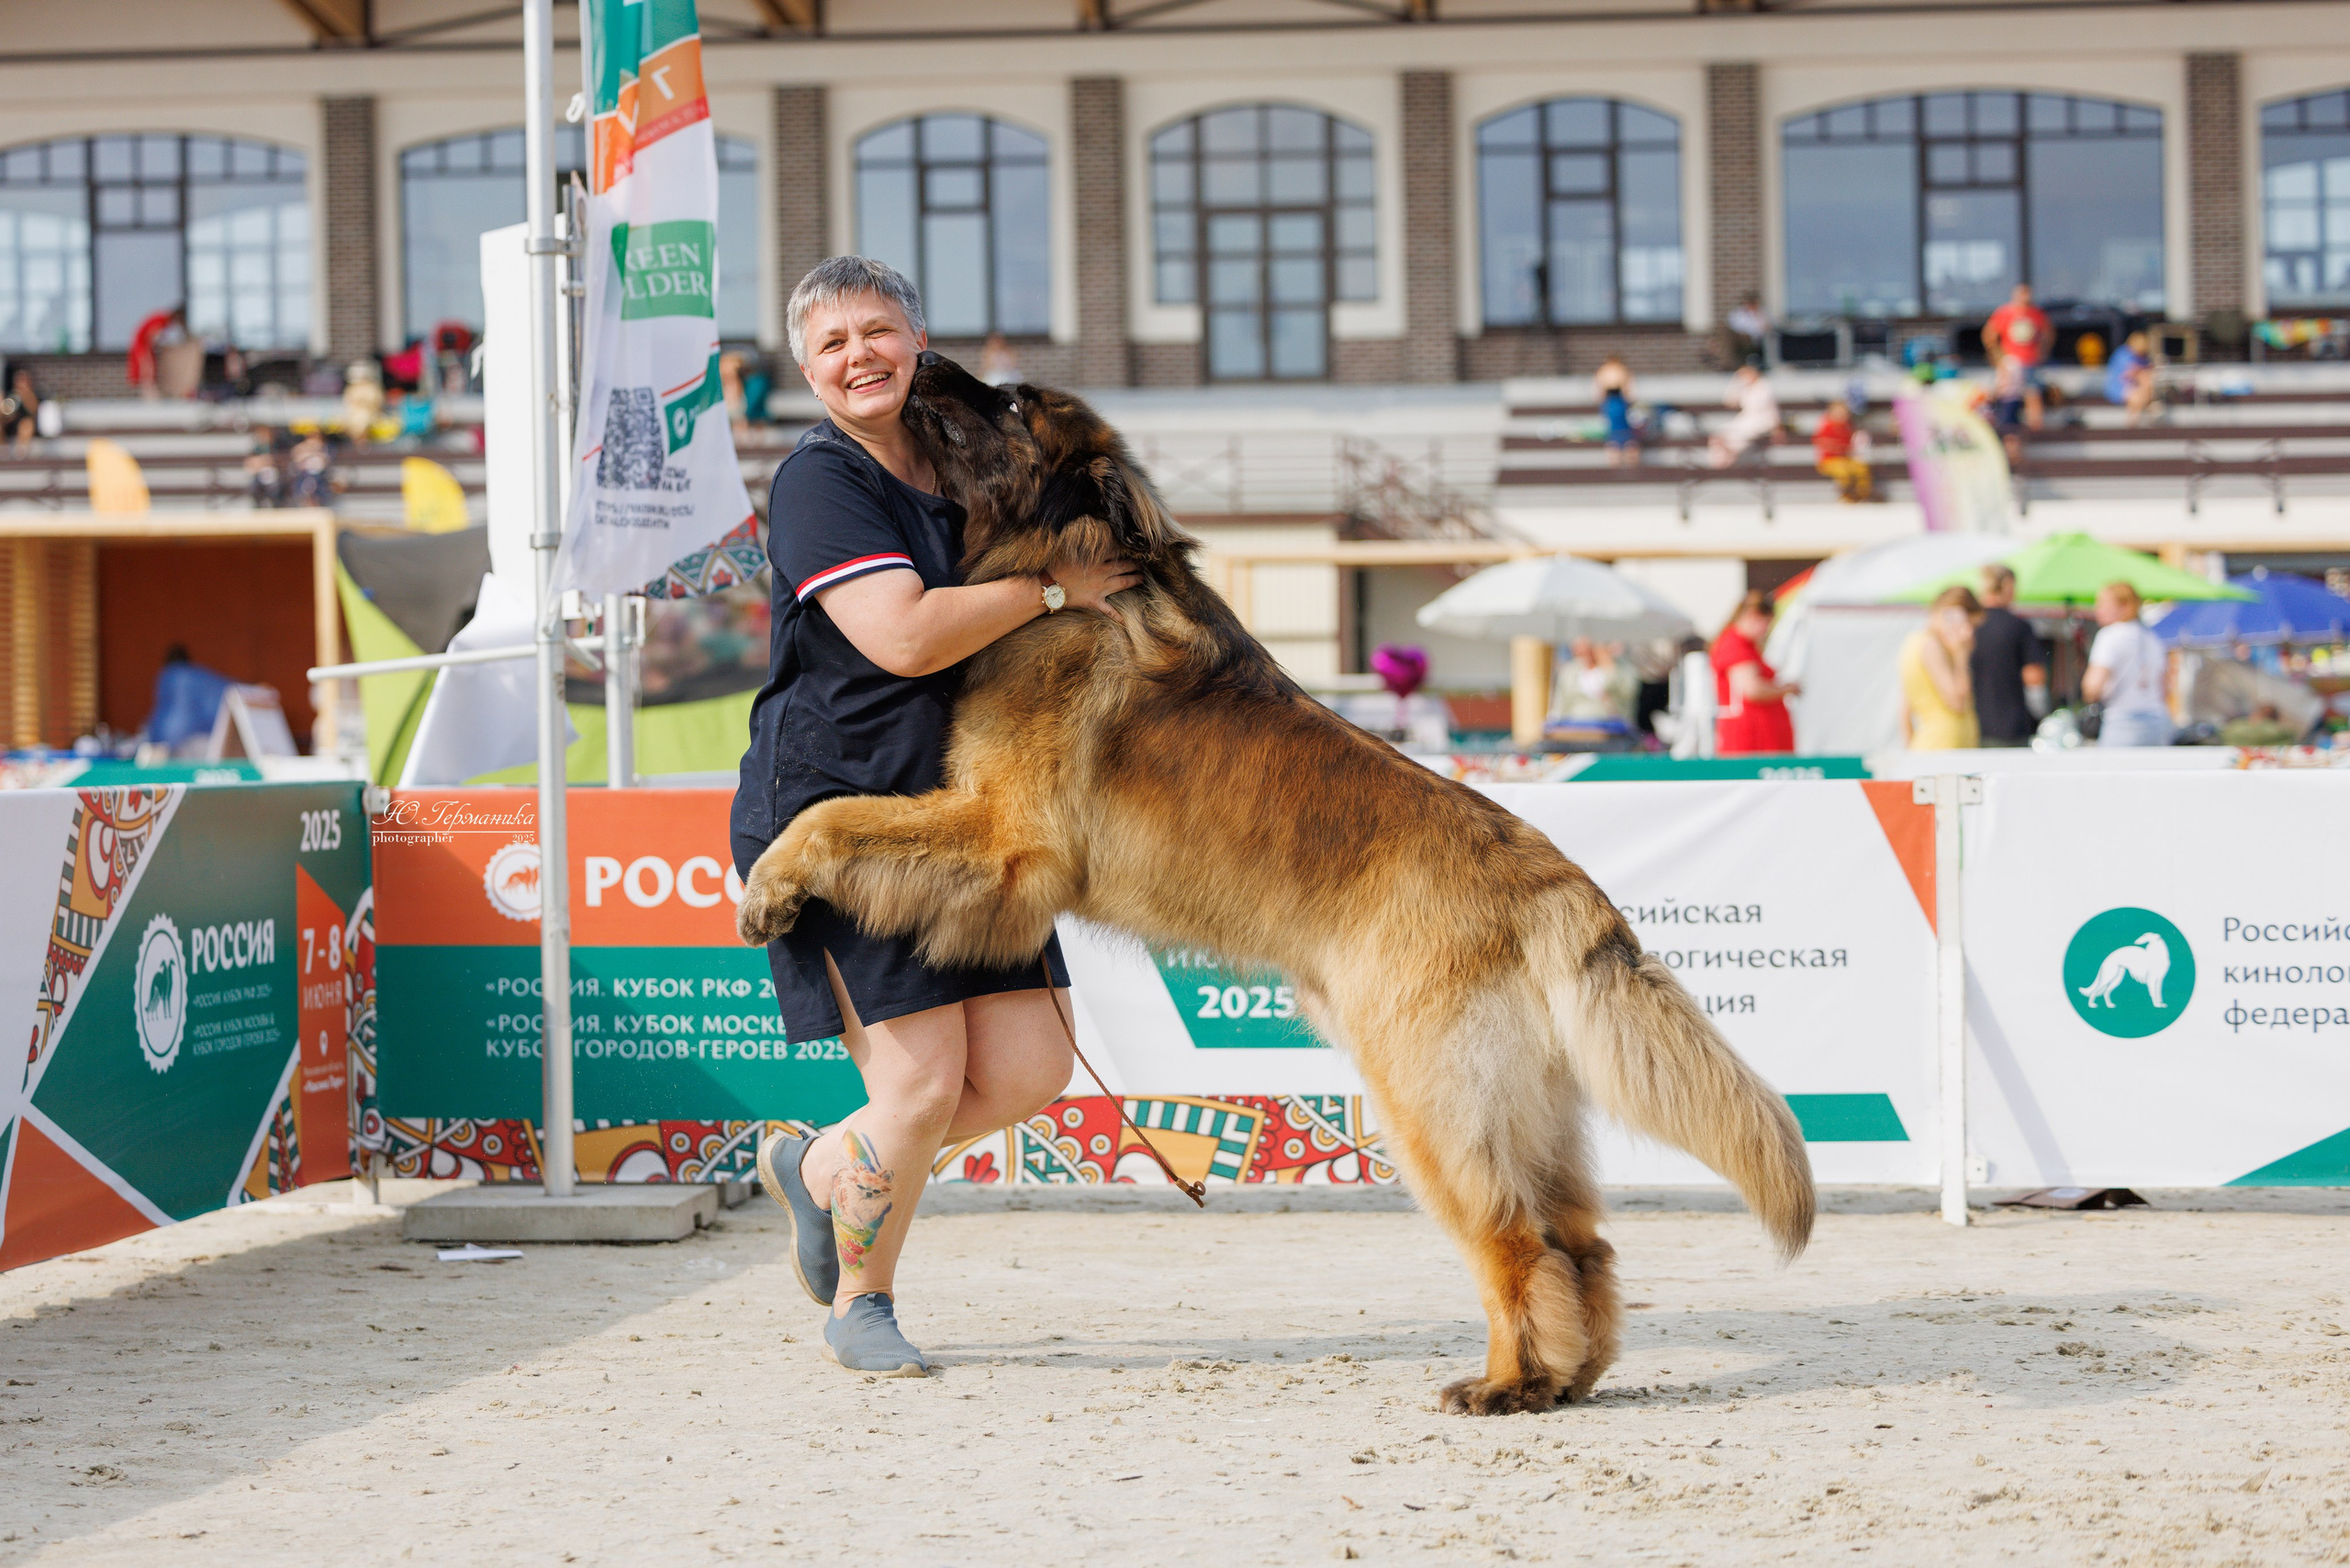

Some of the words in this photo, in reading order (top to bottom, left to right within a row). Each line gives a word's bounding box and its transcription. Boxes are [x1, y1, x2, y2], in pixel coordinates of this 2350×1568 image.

[300, 810, 341, 851] 2025
[192, 918, 274, 975] РОССИЯ
[1649, 947, 1848, 969] огическая
[2224, 966, 2350, 983] киноло
[613, 978, 695, 998] КУБОК
[702, 978, 752, 998] РКФ
[1197, 985, 1297, 1018] 2025
[614, 1014, 695, 1035] КУБОК
[795, 1039, 851, 1060] 2025
